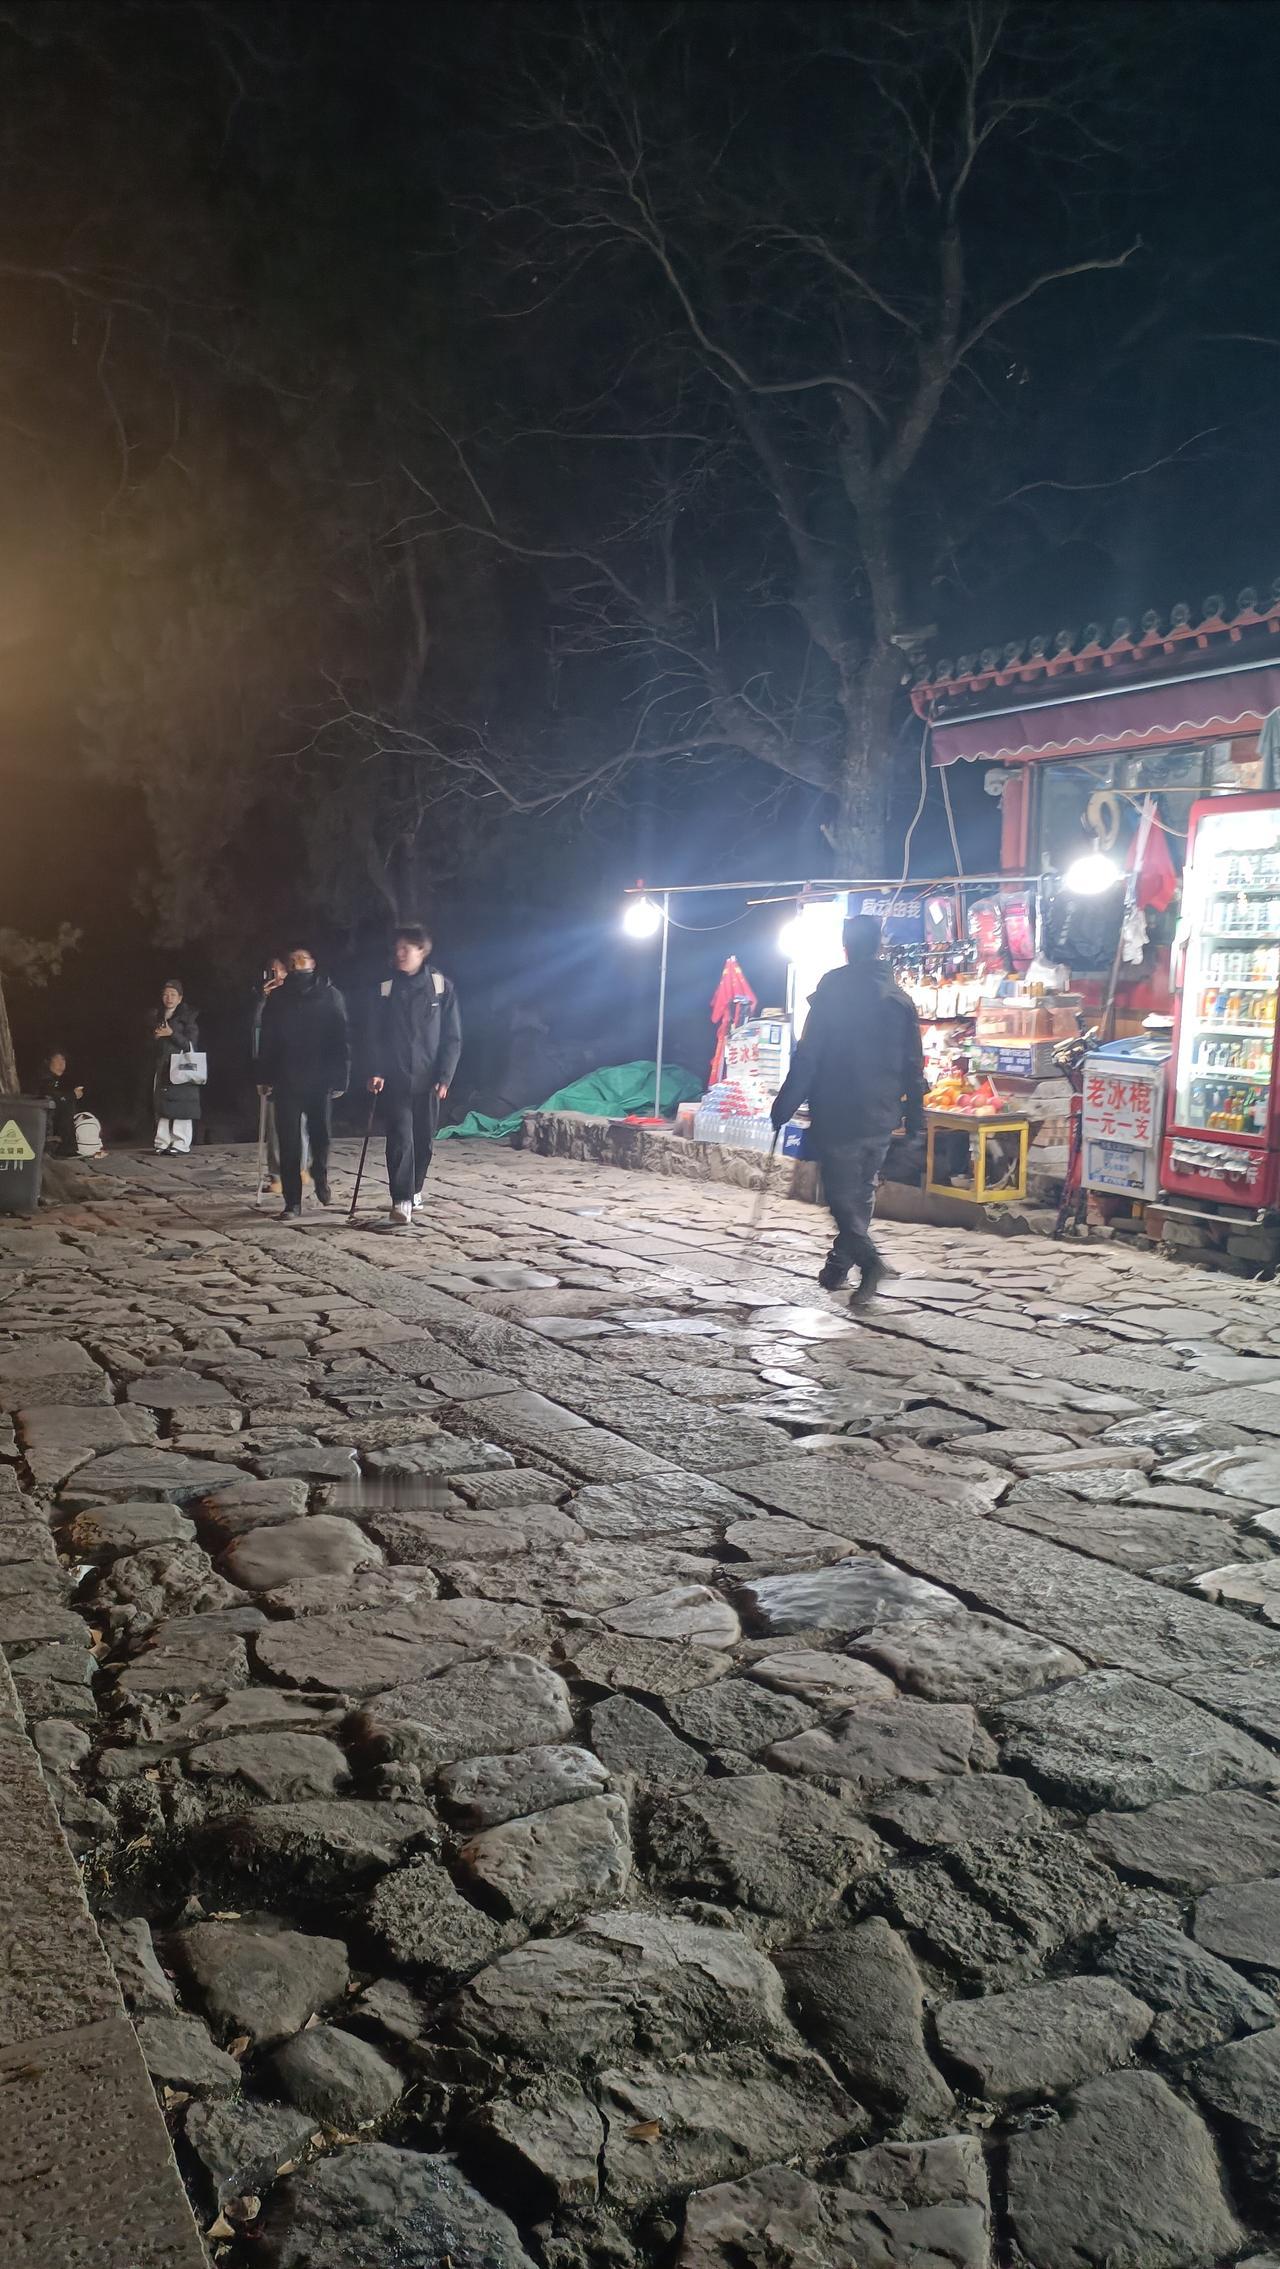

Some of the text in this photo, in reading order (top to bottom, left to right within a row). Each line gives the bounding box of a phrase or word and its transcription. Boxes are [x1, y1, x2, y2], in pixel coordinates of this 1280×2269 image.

[1087, 1076, 1152, 1114] 老冰棍
[1085, 1111, 1150, 1140] 一元一支
